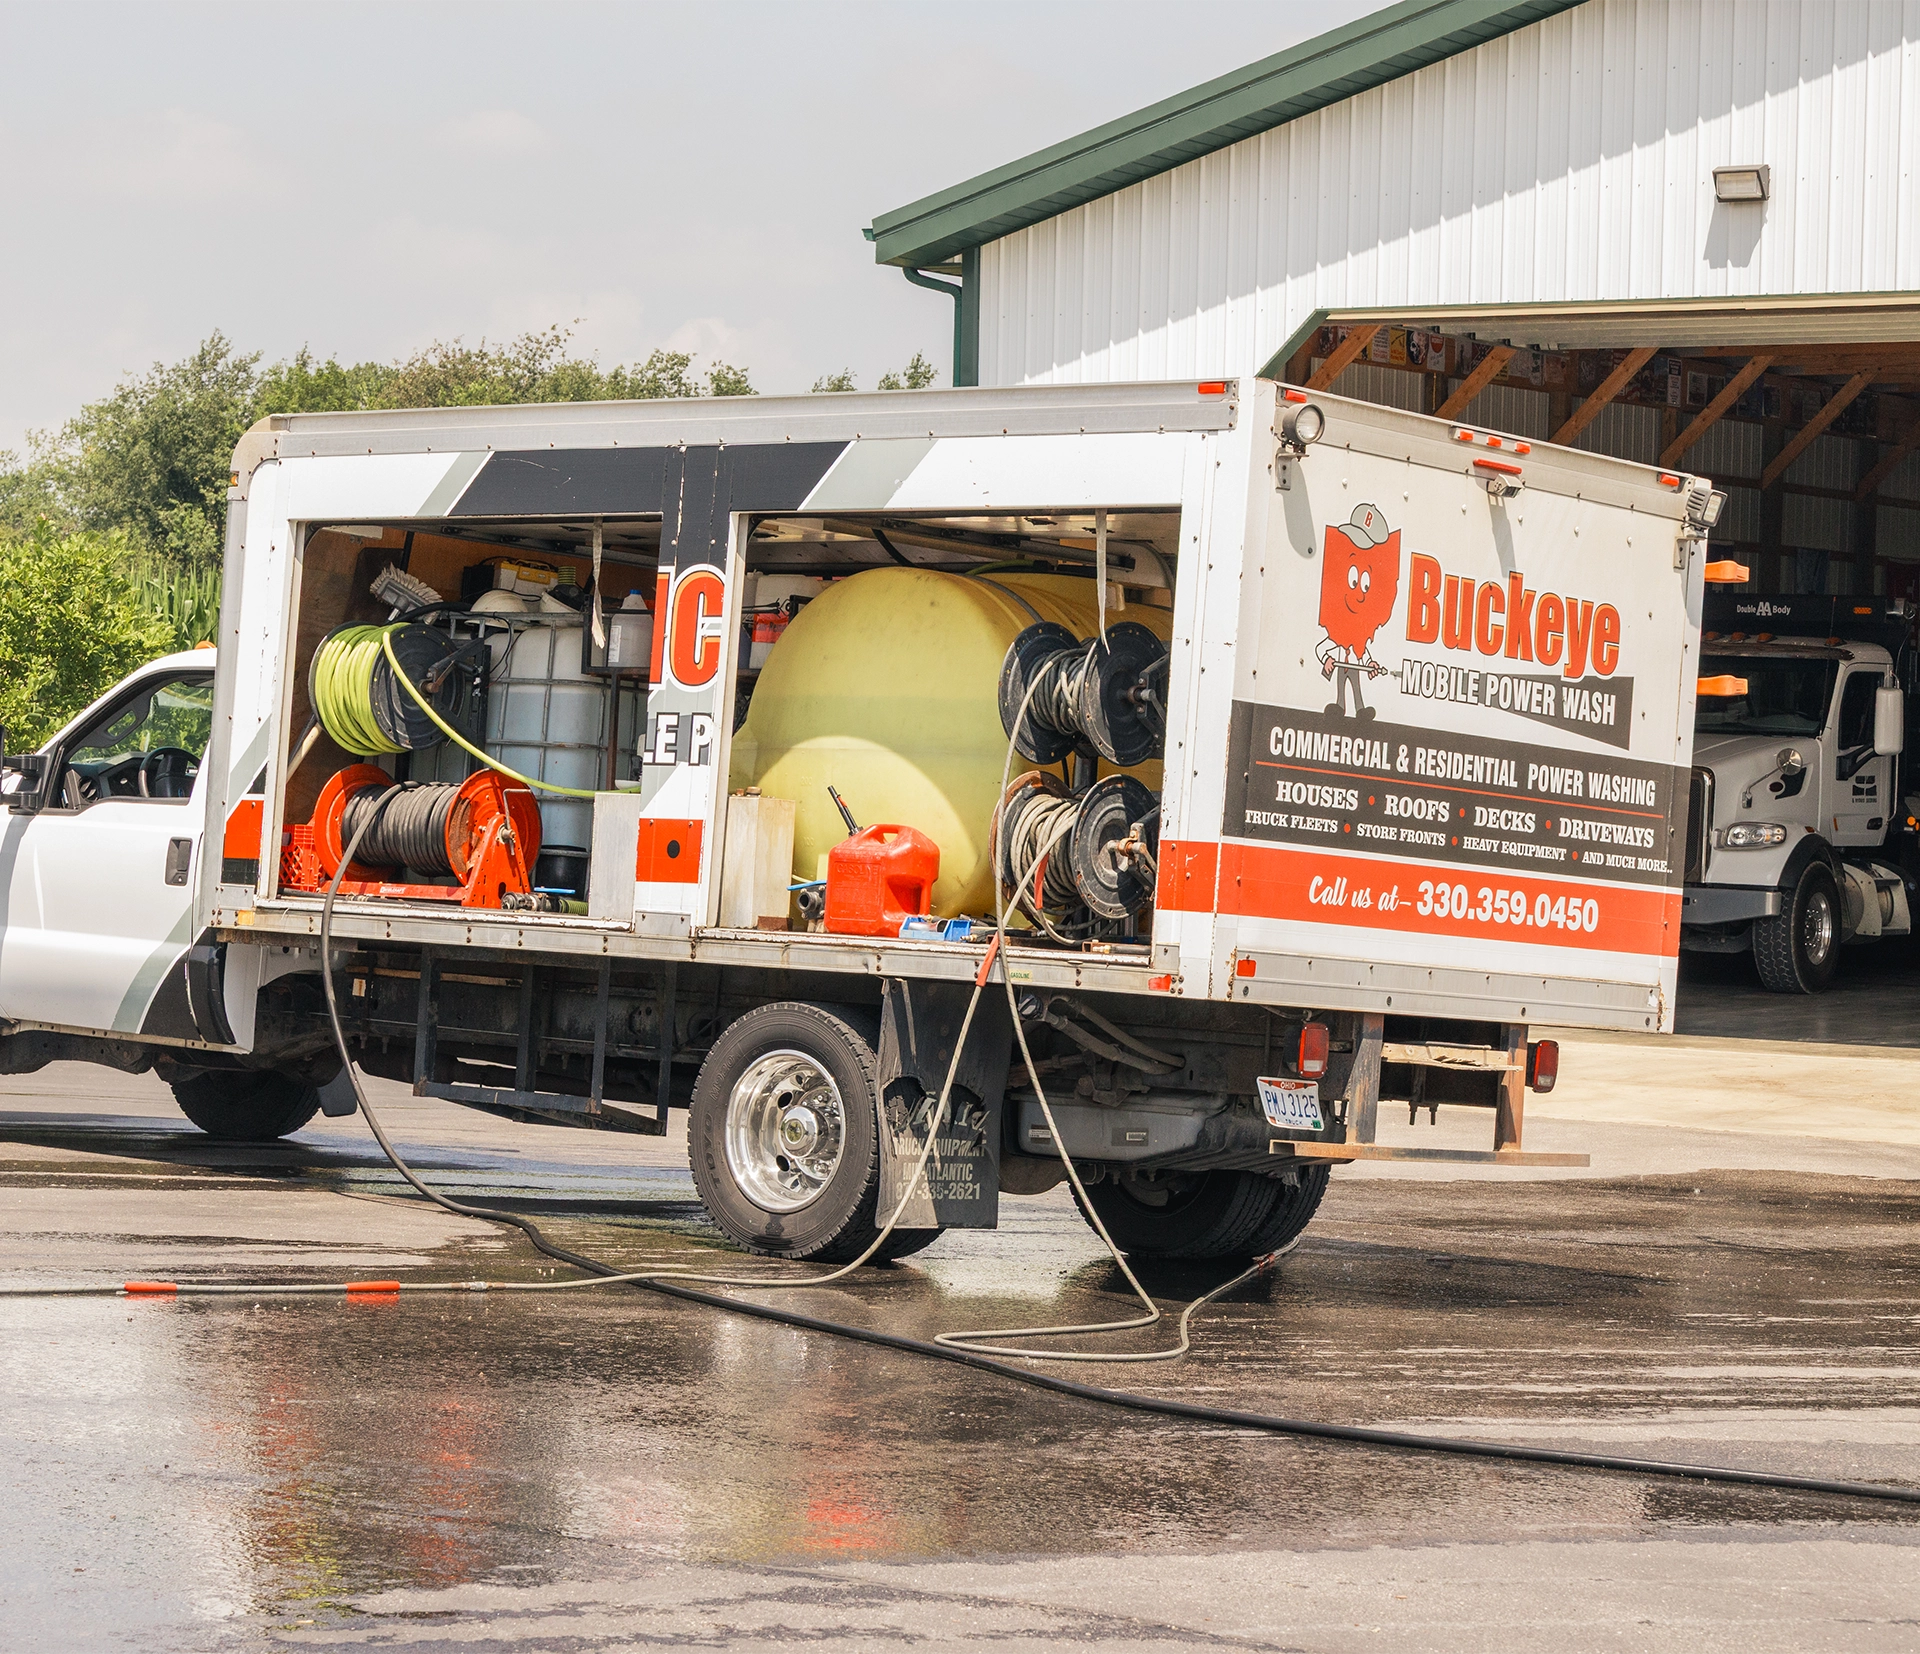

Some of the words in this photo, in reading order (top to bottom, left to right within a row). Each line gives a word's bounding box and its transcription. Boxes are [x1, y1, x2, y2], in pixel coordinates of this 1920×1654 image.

[1363, 510, 1374, 528] B
[1405, 552, 1620, 679] Buckeye
[1736, 605, 1756, 613] Double
[1773, 605, 1791, 616] Body
[1400, 658, 1481, 705] MOBILE
[1484, 672, 1556, 716] POWER
[1562, 687, 1616, 726] WASH
[1269, 726, 1391, 771] COMMERCIAL
[1396, 744, 1409, 773] &
[1414, 746, 1518, 788] RESIDENTIAL
[1527, 763, 1584, 797] POWER
[1588, 771, 1656, 807] WASHING
[1245, 809, 1288, 828] TRUCK
[1290, 815, 1338, 834] FLEETS
[1356, 823, 1397, 841] STORE
[1399, 828, 1446, 847] FRONTS
[1463, 836, 1500, 853] HEAVY
[1501, 841, 1567, 861] EQUIPMENT
[1581, 850, 1604, 866] AND
[1606, 854, 1636, 869] MUCH
[1275, 780, 1359, 811] HOUSES
[1384, 794, 1450, 823] ROOFS
[1474, 806, 1536, 834] DECKS
[1558, 817, 1655, 848] DRIVEWAYS
[1308, 875, 1348, 905] Call
[1350, 883, 1373, 909] us
[1415, 880, 1599, 933] 330.359.0450
[1010, 971, 1030, 979] GASOLINE
[1280, 1081, 1296, 1089] OHIO
[1288, 1093, 1318, 1118] 3125
[704, 1113, 721, 1190] TOYO
